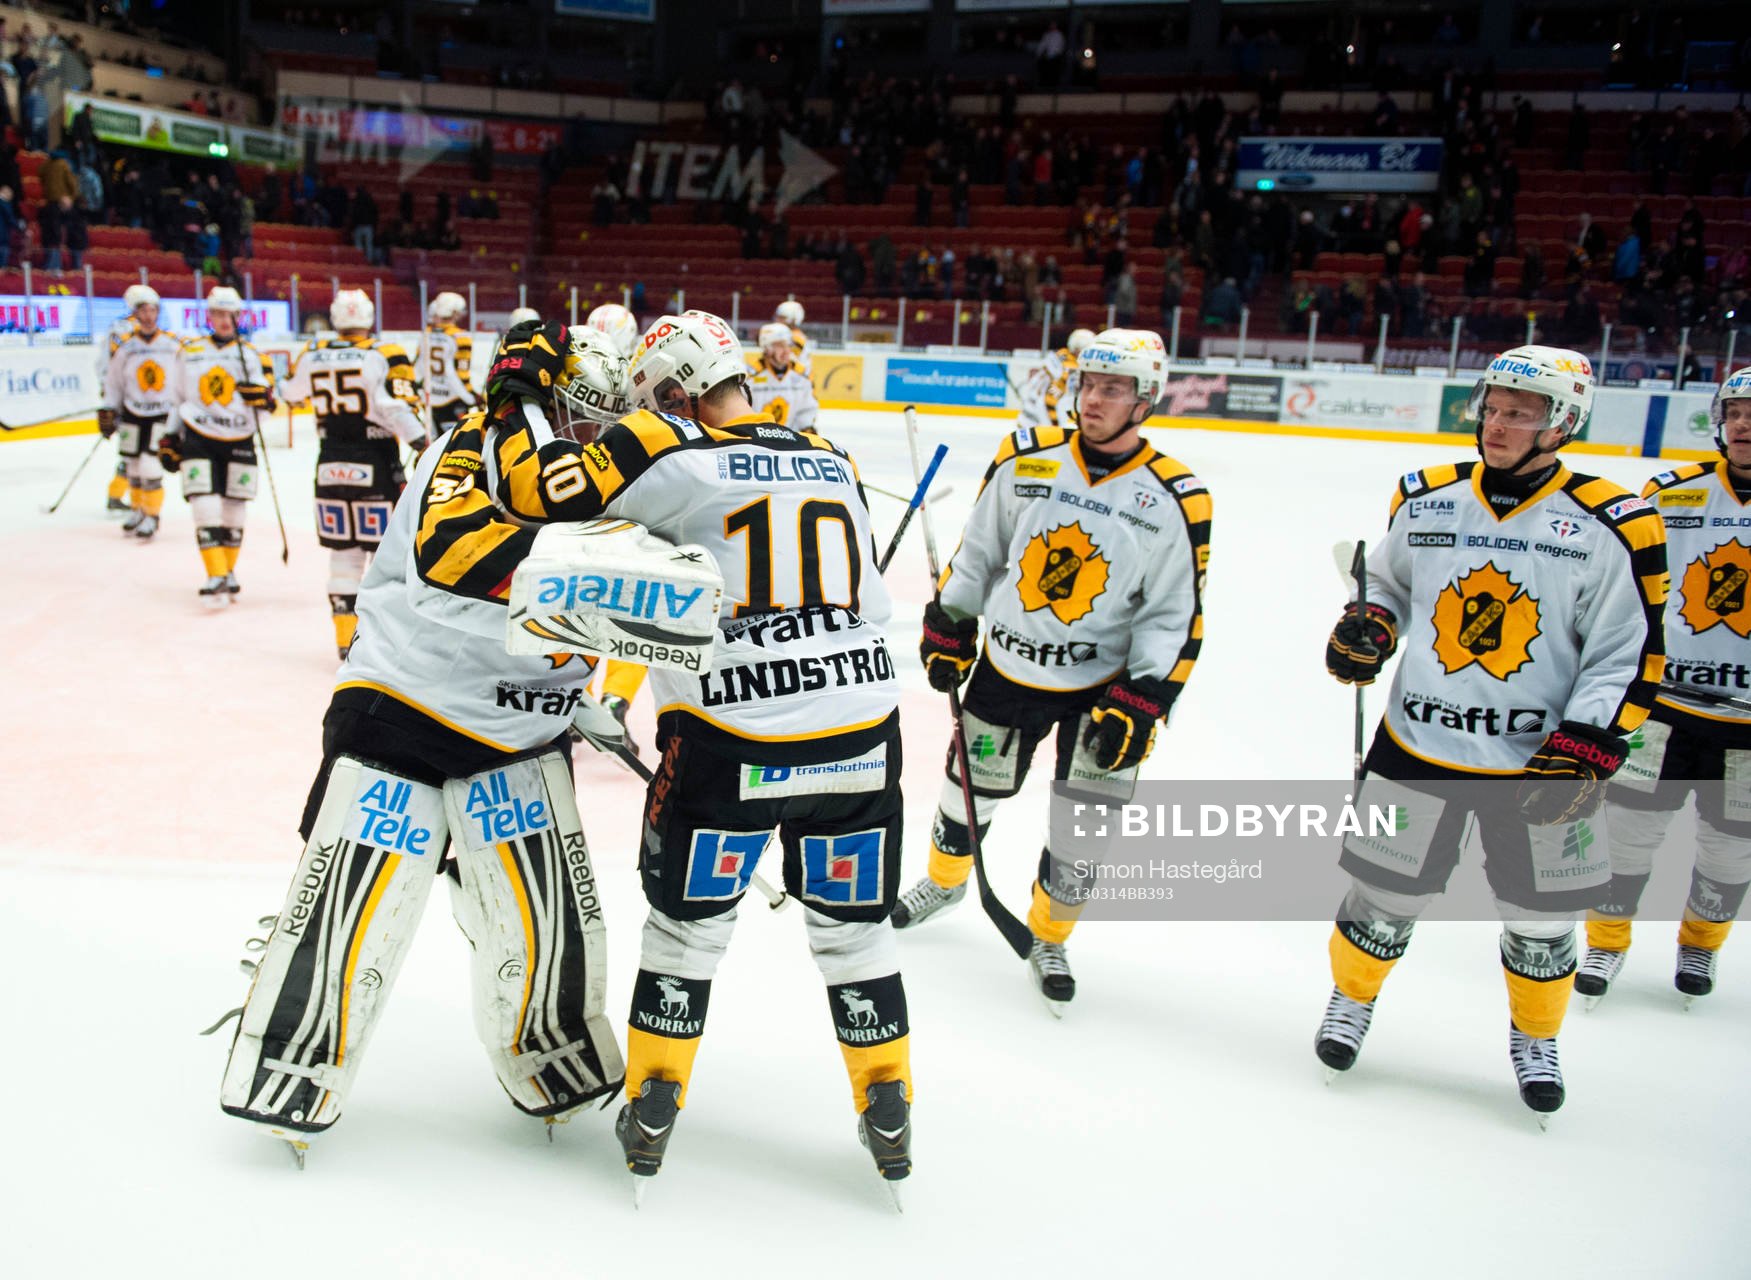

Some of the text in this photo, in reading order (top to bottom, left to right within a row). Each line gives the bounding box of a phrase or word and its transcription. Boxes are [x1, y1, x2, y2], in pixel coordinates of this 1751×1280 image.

[626, 140, 765, 212] ITEM
[676, 363, 695, 382] 10
[1490, 359, 1539, 378] AllTele
[310, 368, 369, 419] 55
[573, 383, 626, 414] BOLID
[755, 427, 797, 442] Reebok
[542, 453, 588, 503] 10
[729, 453, 851, 485] BOLIDEN
[1060, 491, 1113, 517] BOLIDEN
[1118, 510, 1160, 534] engcon
[1423, 501, 1455, 510] LEAB
[1712, 517, 1751, 527] BOLID
[723, 493, 862, 618] 10
[1467, 535, 1529, 552] BOLIDEN
[1535, 543, 1588, 561] engcon
[538, 574, 704, 619] AllTele
[609, 638, 702, 672] Reebok
[991, 624, 1067, 667] kraft
[496, 685, 584, 716] kraf
[1110, 685, 1160, 717] Reebok
[1403, 696, 1500, 736] kraft
[796, 759, 886, 776] transbothnia
[1548, 731, 1622, 773] Reebok
[359, 779, 413, 815] All
[465, 770, 511, 813] All
[360, 806, 431, 856] Tele
[471, 797, 549, 843] Tele
[563, 830, 601, 925] Reebok
[1541, 858, 1609, 879] martinsons
[281, 842, 335, 937] Reebok
[1507, 961, 1572, 980] NORRAN
[637, 1011, 702, 1034] NORRAN
[837, 1021, 899, 1043] NORRAN
